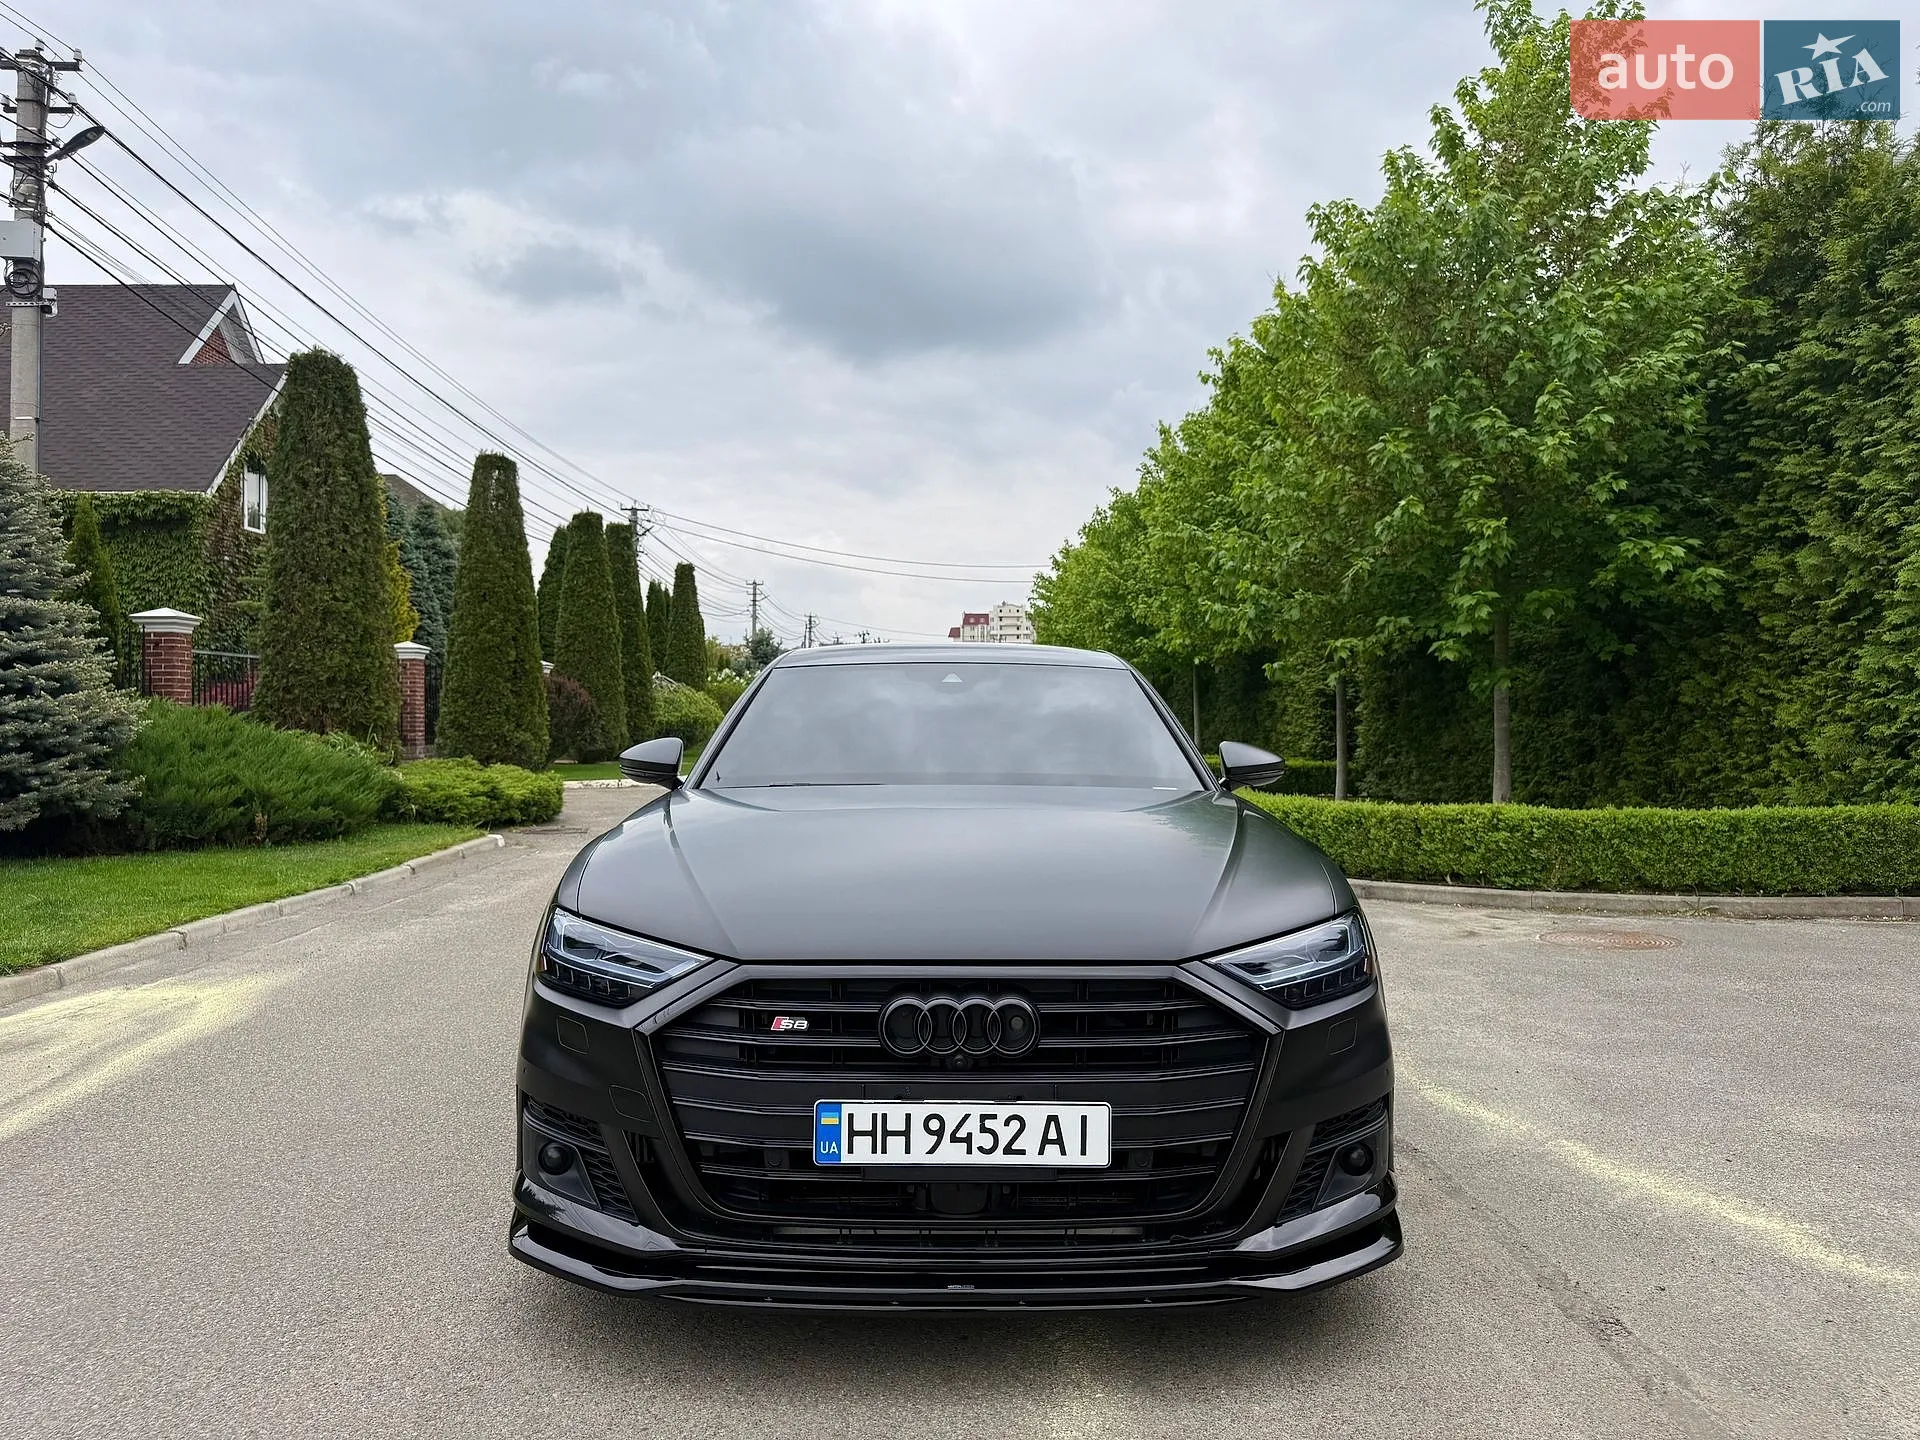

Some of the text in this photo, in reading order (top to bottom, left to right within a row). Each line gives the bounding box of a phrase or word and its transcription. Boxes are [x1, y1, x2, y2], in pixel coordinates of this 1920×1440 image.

[779, 1019, 808, 1030] S8
[847, 1112, 1088, 1157] HH 9452 AI
[820, 1141, 839, 1155] UA
